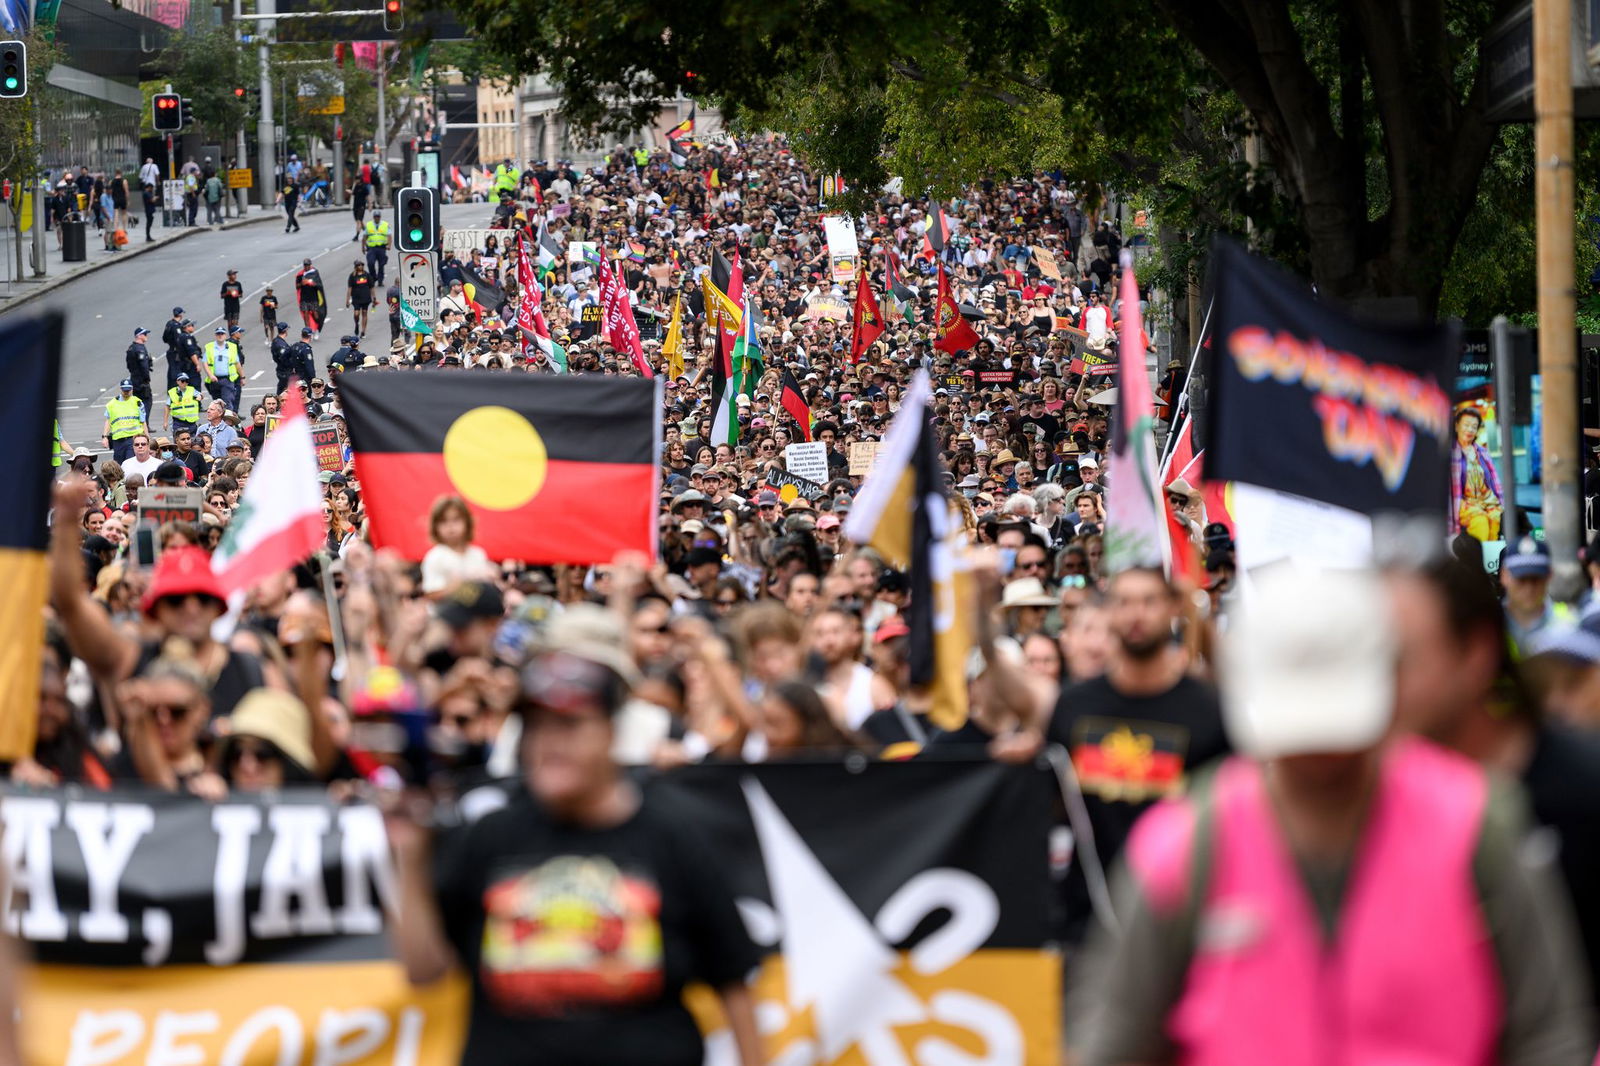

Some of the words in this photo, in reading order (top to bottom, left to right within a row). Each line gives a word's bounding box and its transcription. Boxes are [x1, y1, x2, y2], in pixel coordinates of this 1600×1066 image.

[448, 231, 478, 249] RESIST
[408, 285, 426, 296] NO
[1460, 362, 1488, 372] Sydney
[313, 431, 335, 443] TOP
[320, 446, 339, 456] ACK
[320, 456, 340, 465] ATHS
[766, 469, 803, 489] ALWAYS
